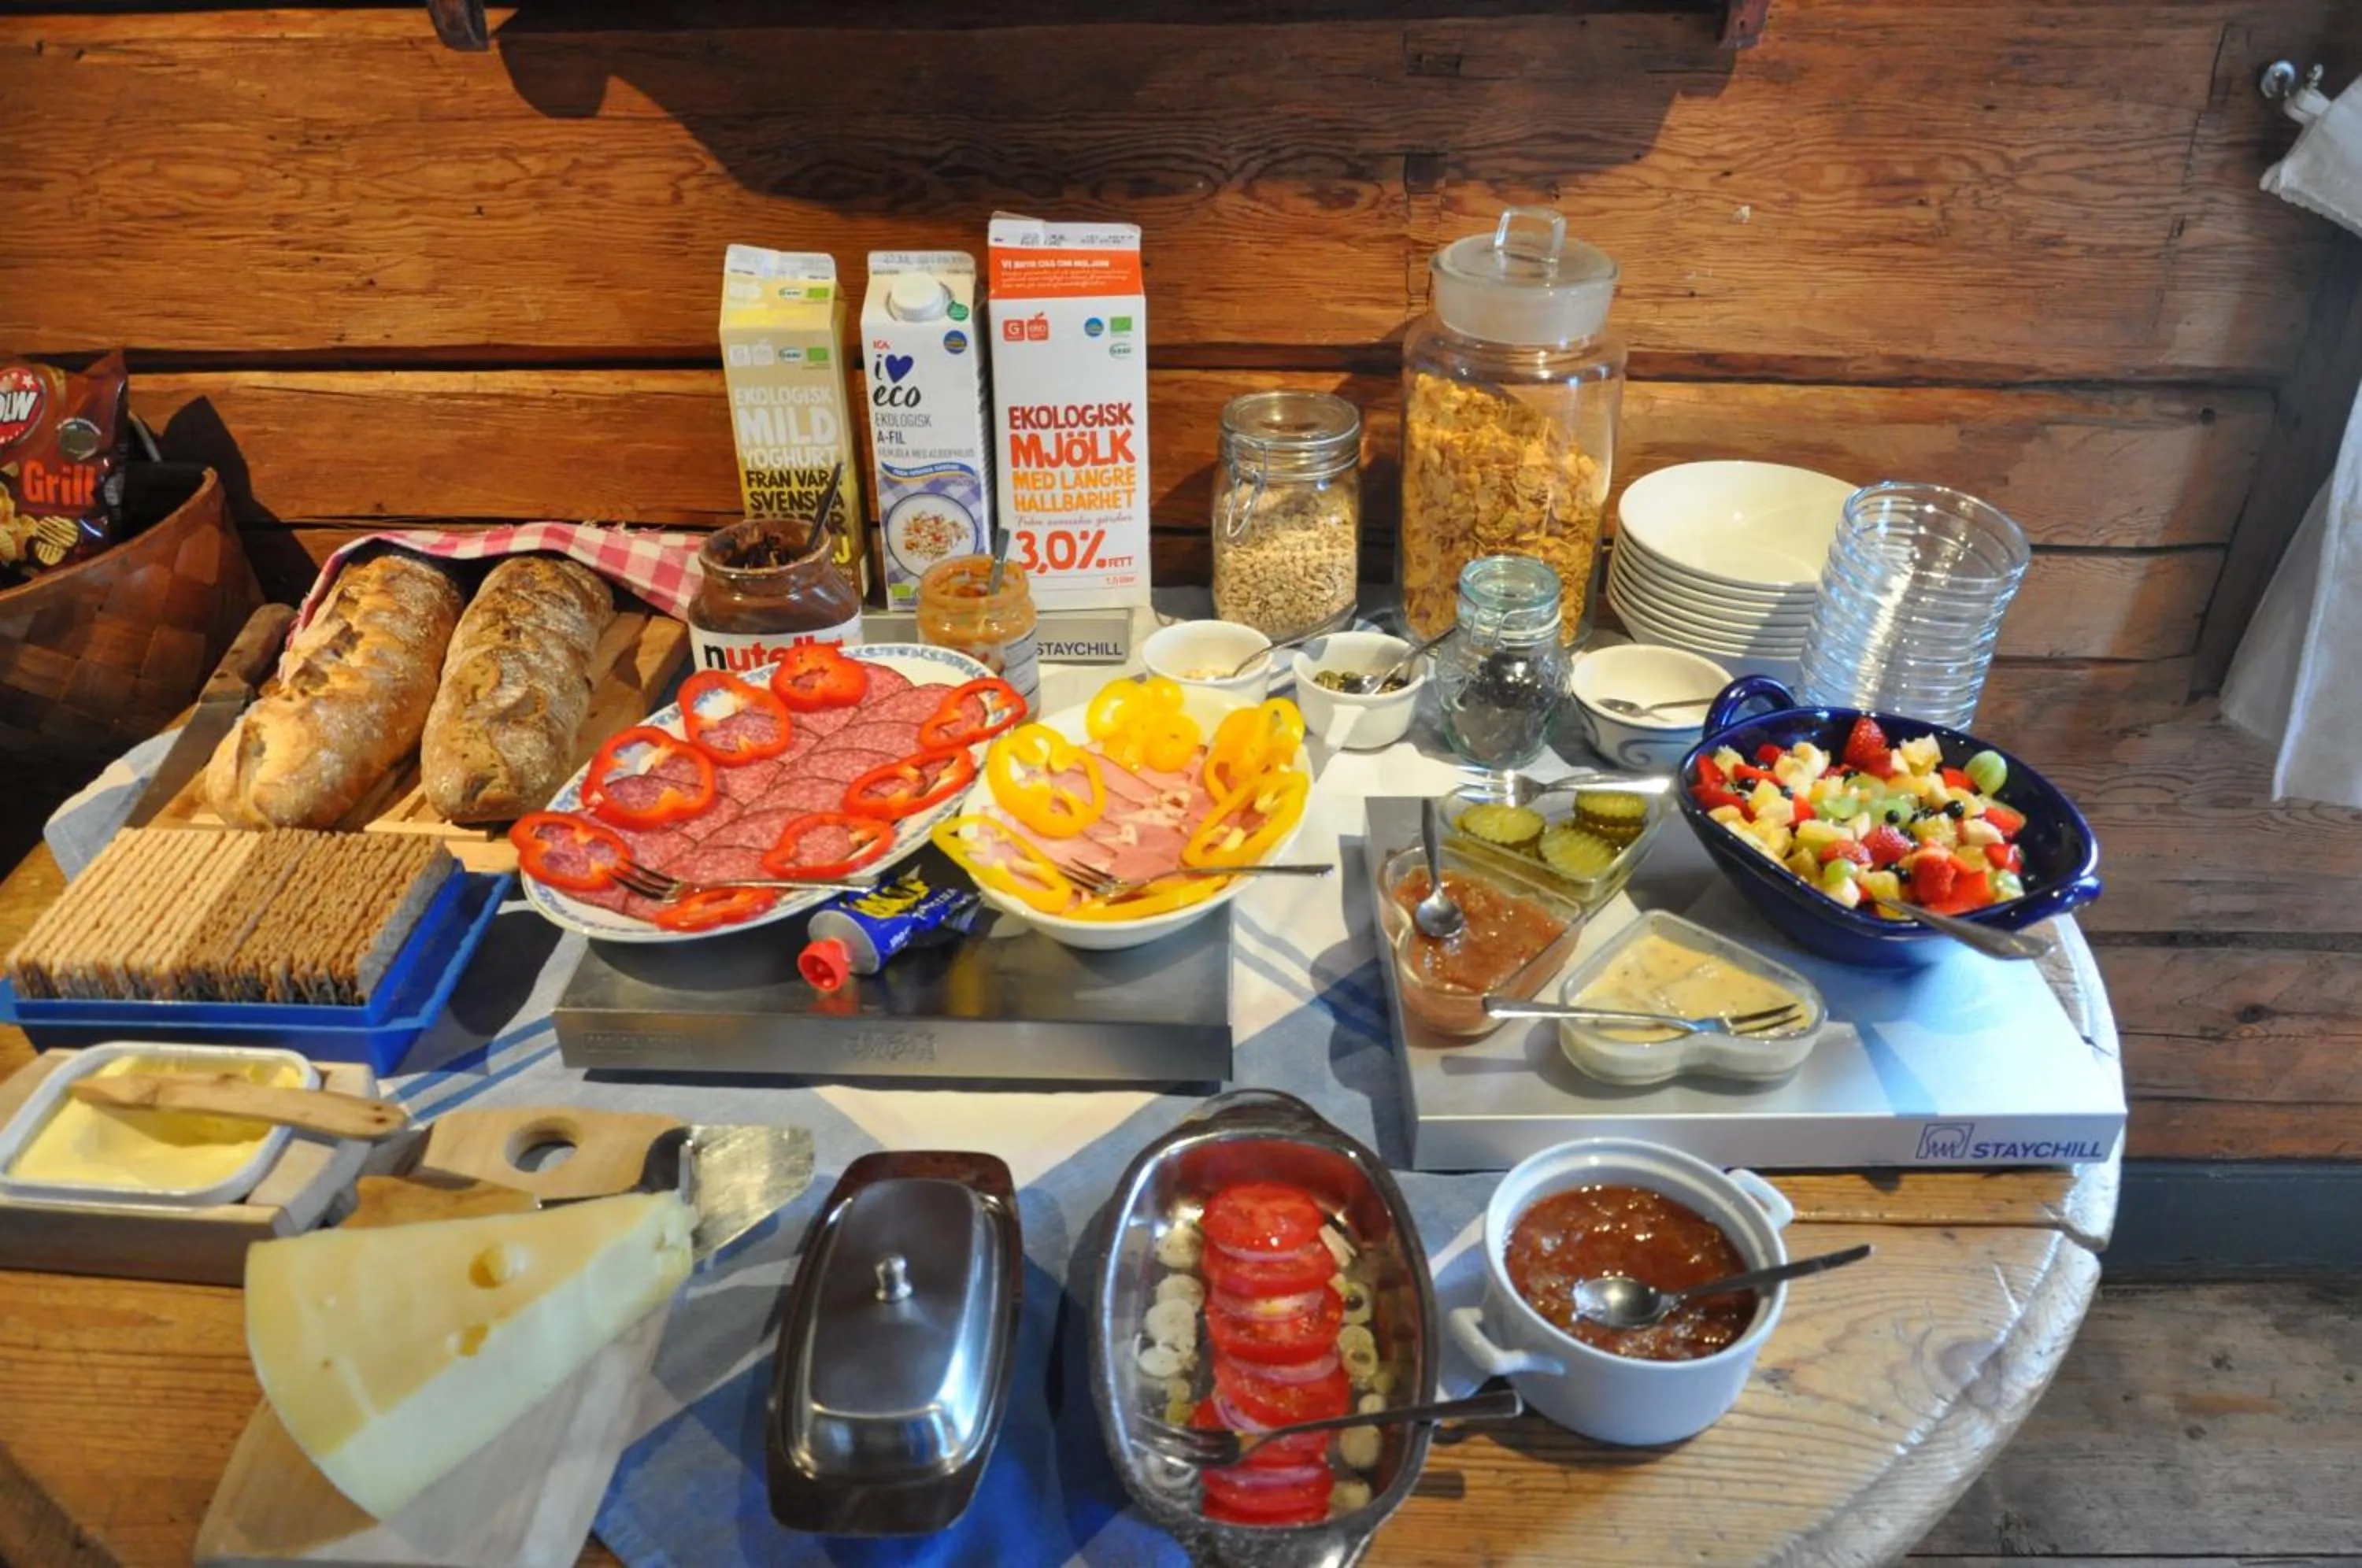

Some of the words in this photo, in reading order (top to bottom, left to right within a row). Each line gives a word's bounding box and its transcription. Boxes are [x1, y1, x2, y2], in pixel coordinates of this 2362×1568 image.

[734, 386, 834, 406] EKOLOGISK
[873, 386, 921, 408] eco
[737, 406, 836, 446] MILD
[876, 412, 932, 427] EKOLOGISK
[1008, 403, 1134, 430] EKOLOGISK
[742, 446, 839, 468] YOGHURT
[1010, 430, 1135, 468] MJÖLK
[1013, 470, 1056, 492] MED
[1109, 557, 1133, 568] FETT
[704, 634, 843, 671] nute
[1037, 642, 1124, 656] STAYCHILL
[1971, 1141, 2102, 1159] STAYCHILL
